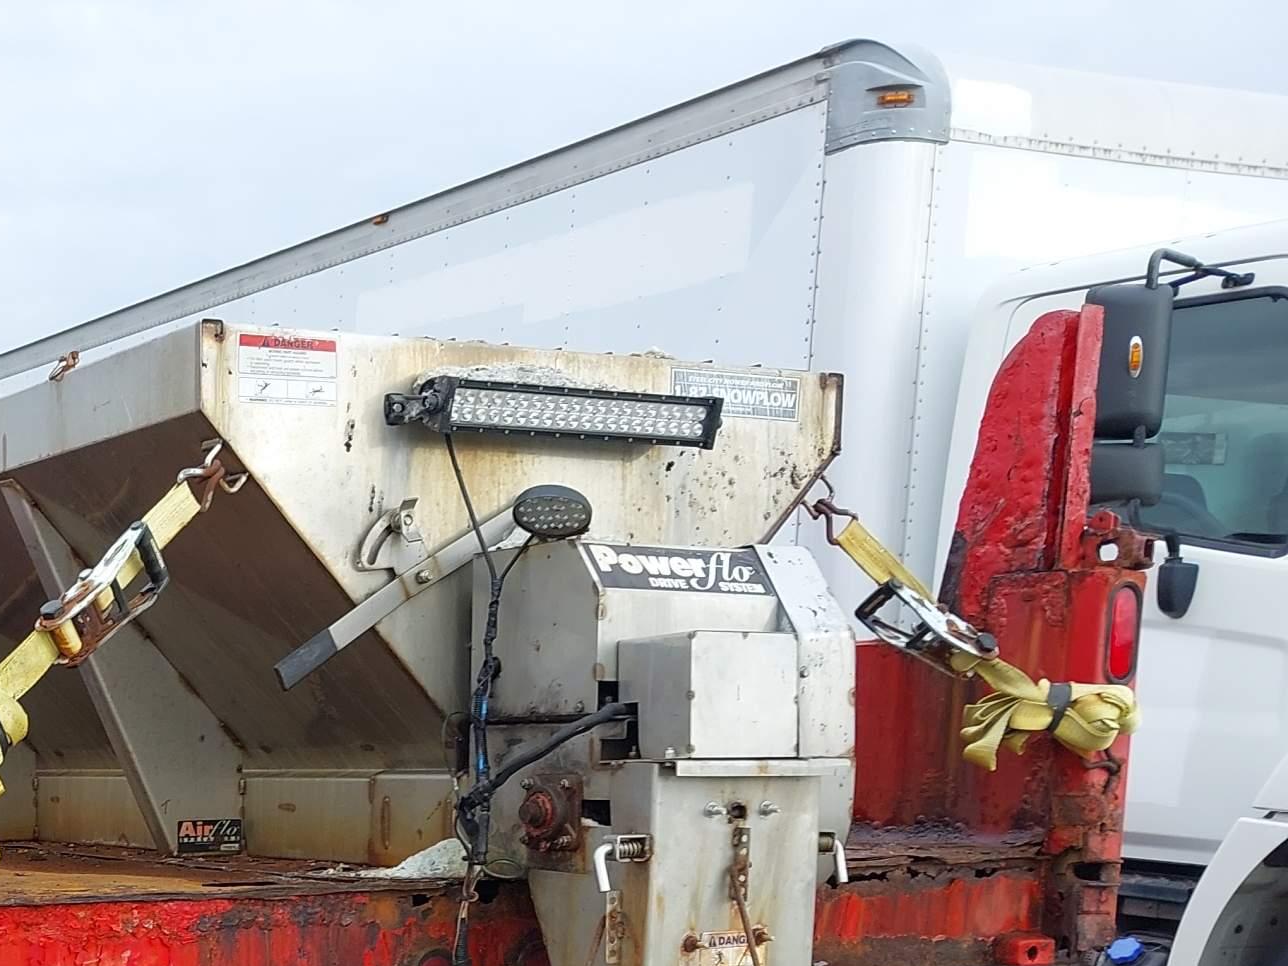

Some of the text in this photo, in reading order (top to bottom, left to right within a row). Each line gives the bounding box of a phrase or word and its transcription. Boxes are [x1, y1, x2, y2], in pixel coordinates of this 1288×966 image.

[274, 338, 312, 348] DANGER
[648, 577, 766, 593] DRIVE SYSTEM
[179, 820, 240, 838] Airflo
[718, 935, 746, 946] DANG
